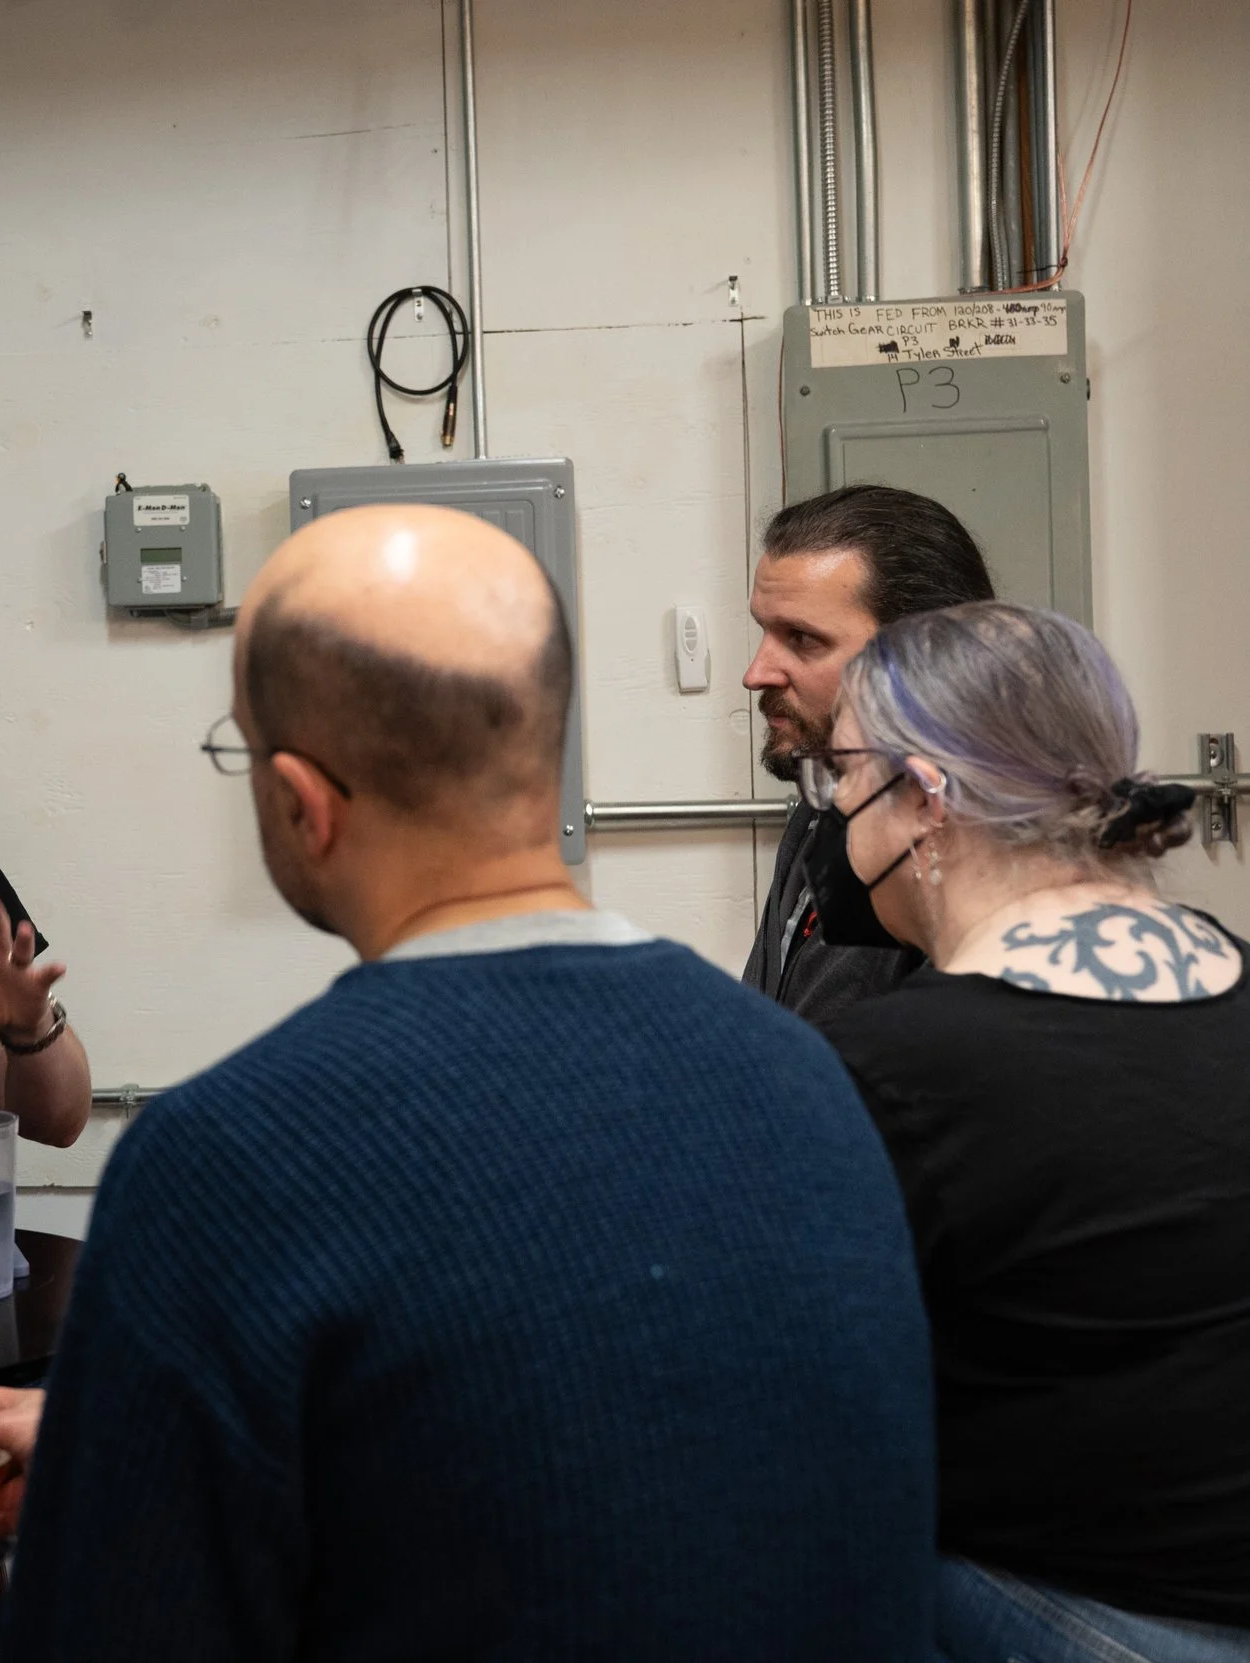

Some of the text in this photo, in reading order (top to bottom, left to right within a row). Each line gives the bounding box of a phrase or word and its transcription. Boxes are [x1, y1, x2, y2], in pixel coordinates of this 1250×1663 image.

[816, 308, 843, 322] THIS
[850, 307, 861, 318] IS
[876, 308, 902, 322] FED
[912, 306, 947, 319] FROM
[886, 322, 937, 337] CIRCUIT
[949, 317, 987, 331] BRKR
[902, 335, 919, 347] P3
[896, 366, 960, 413] P3
